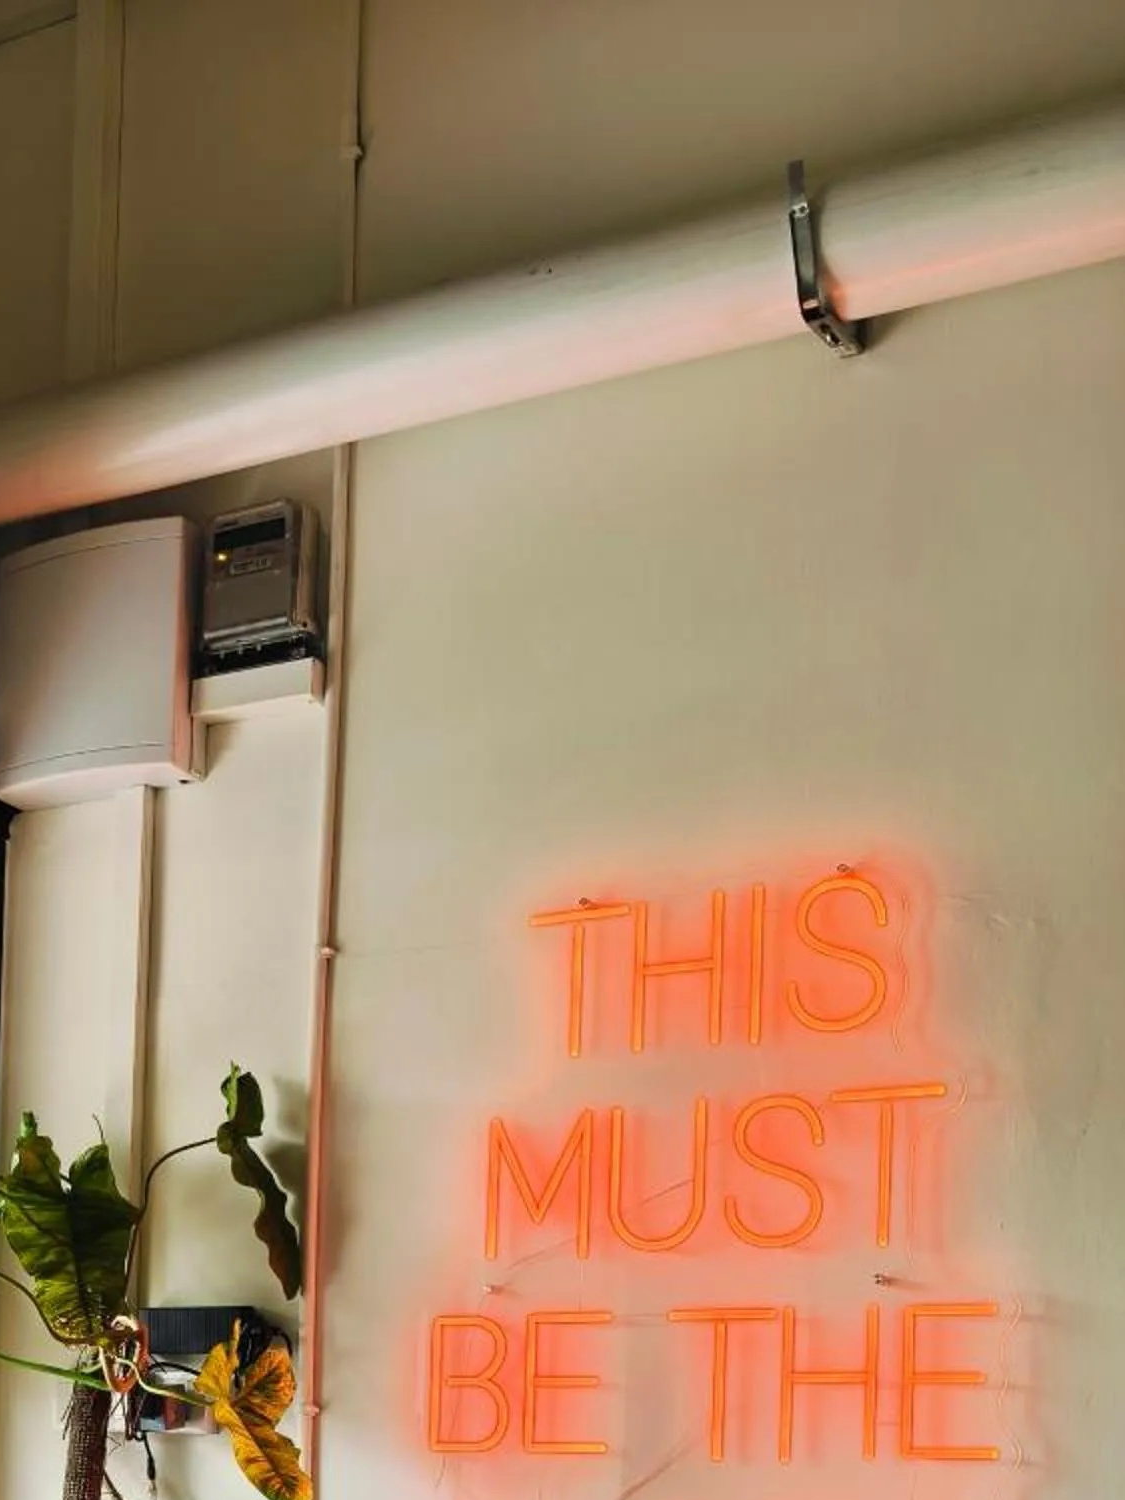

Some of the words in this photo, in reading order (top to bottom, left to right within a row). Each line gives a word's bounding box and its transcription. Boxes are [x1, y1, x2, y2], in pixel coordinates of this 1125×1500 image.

[529, 876, 888, 1057] THIS
[485, 1083, 947, 1259] MUST
[428, 1311, 614, 1455] BE
[667, 1304, 1000, 1464] THE
